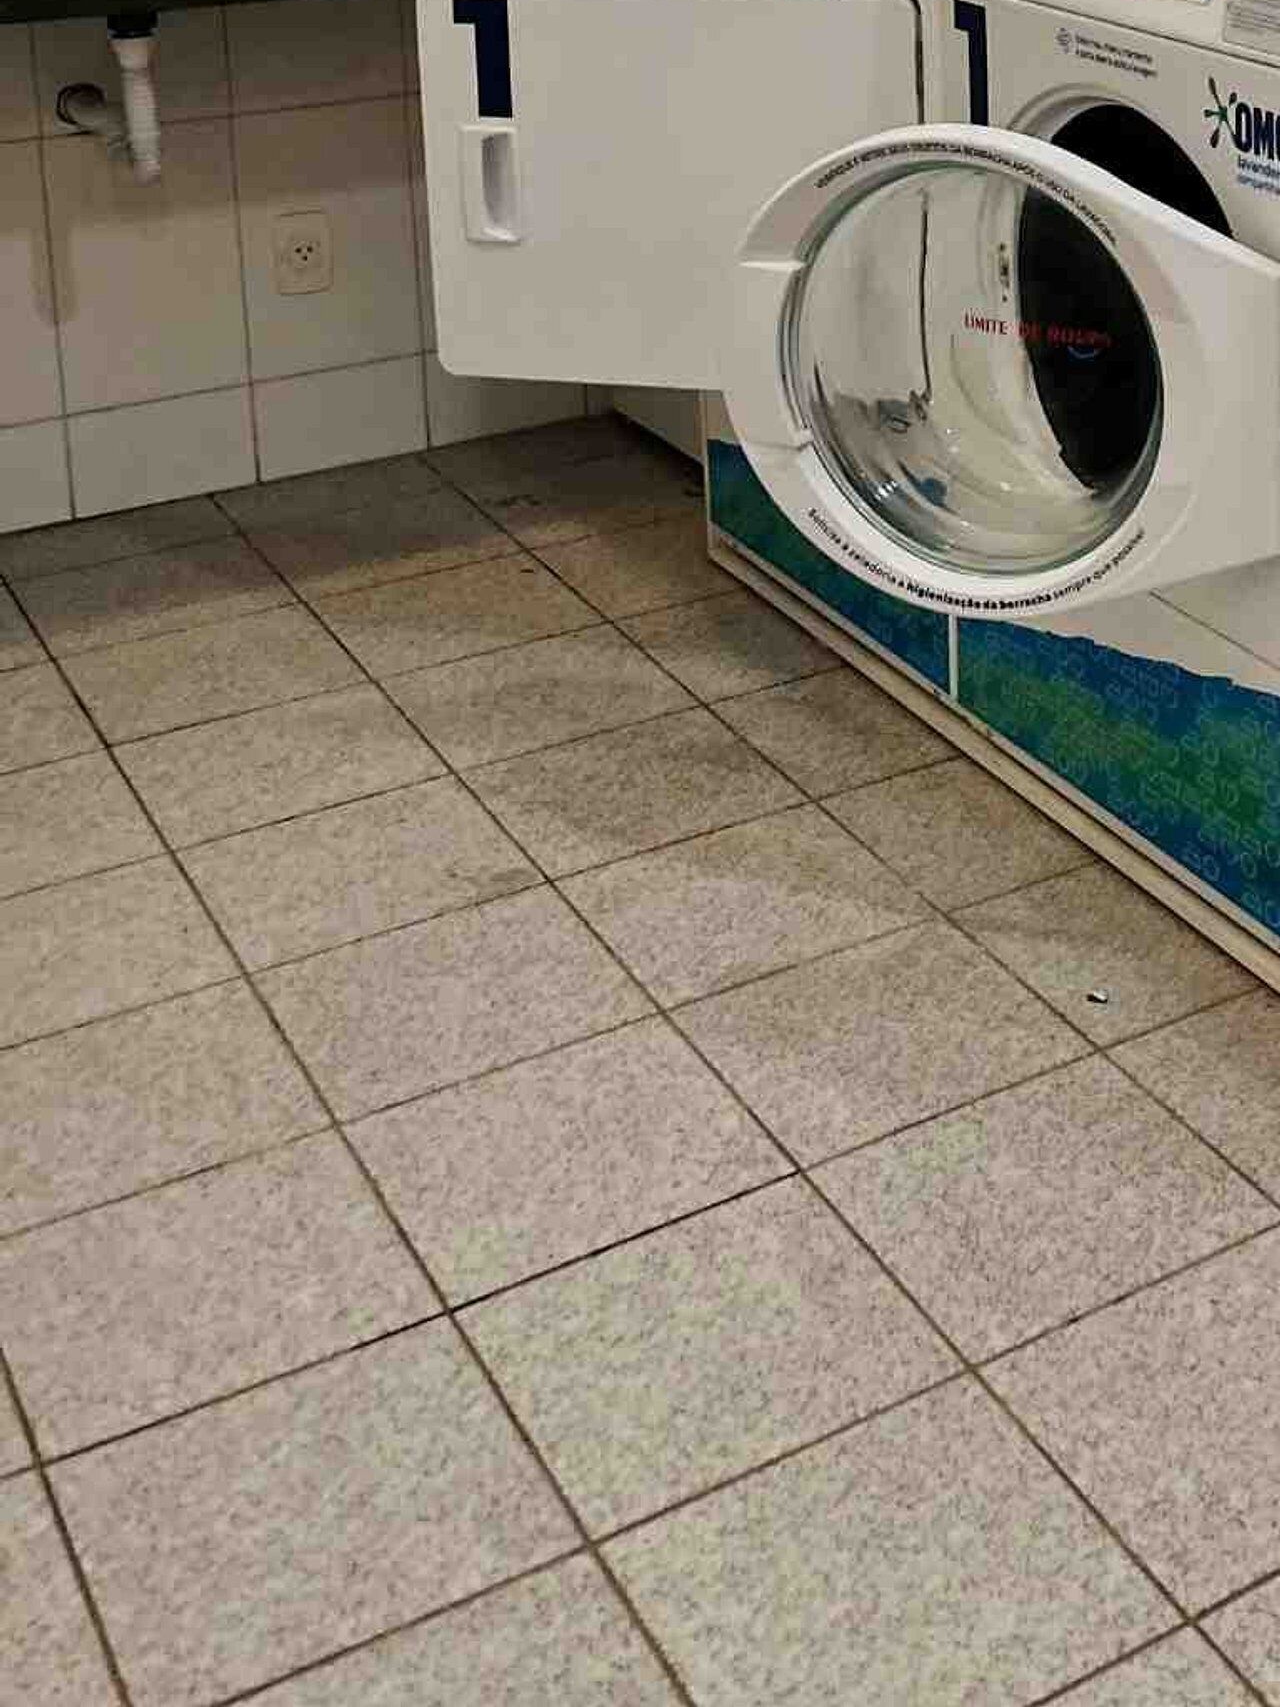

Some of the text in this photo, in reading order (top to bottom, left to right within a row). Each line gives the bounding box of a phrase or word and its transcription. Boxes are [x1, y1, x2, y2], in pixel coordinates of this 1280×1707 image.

[964, 310, 1008, 336] LIMITE
[906, 581, 980, 611] higienização
[983, 597, 998, 609] da
[1000, 593, 1051, 610] borracha
[1053, 576, 1091, 599] sempre
